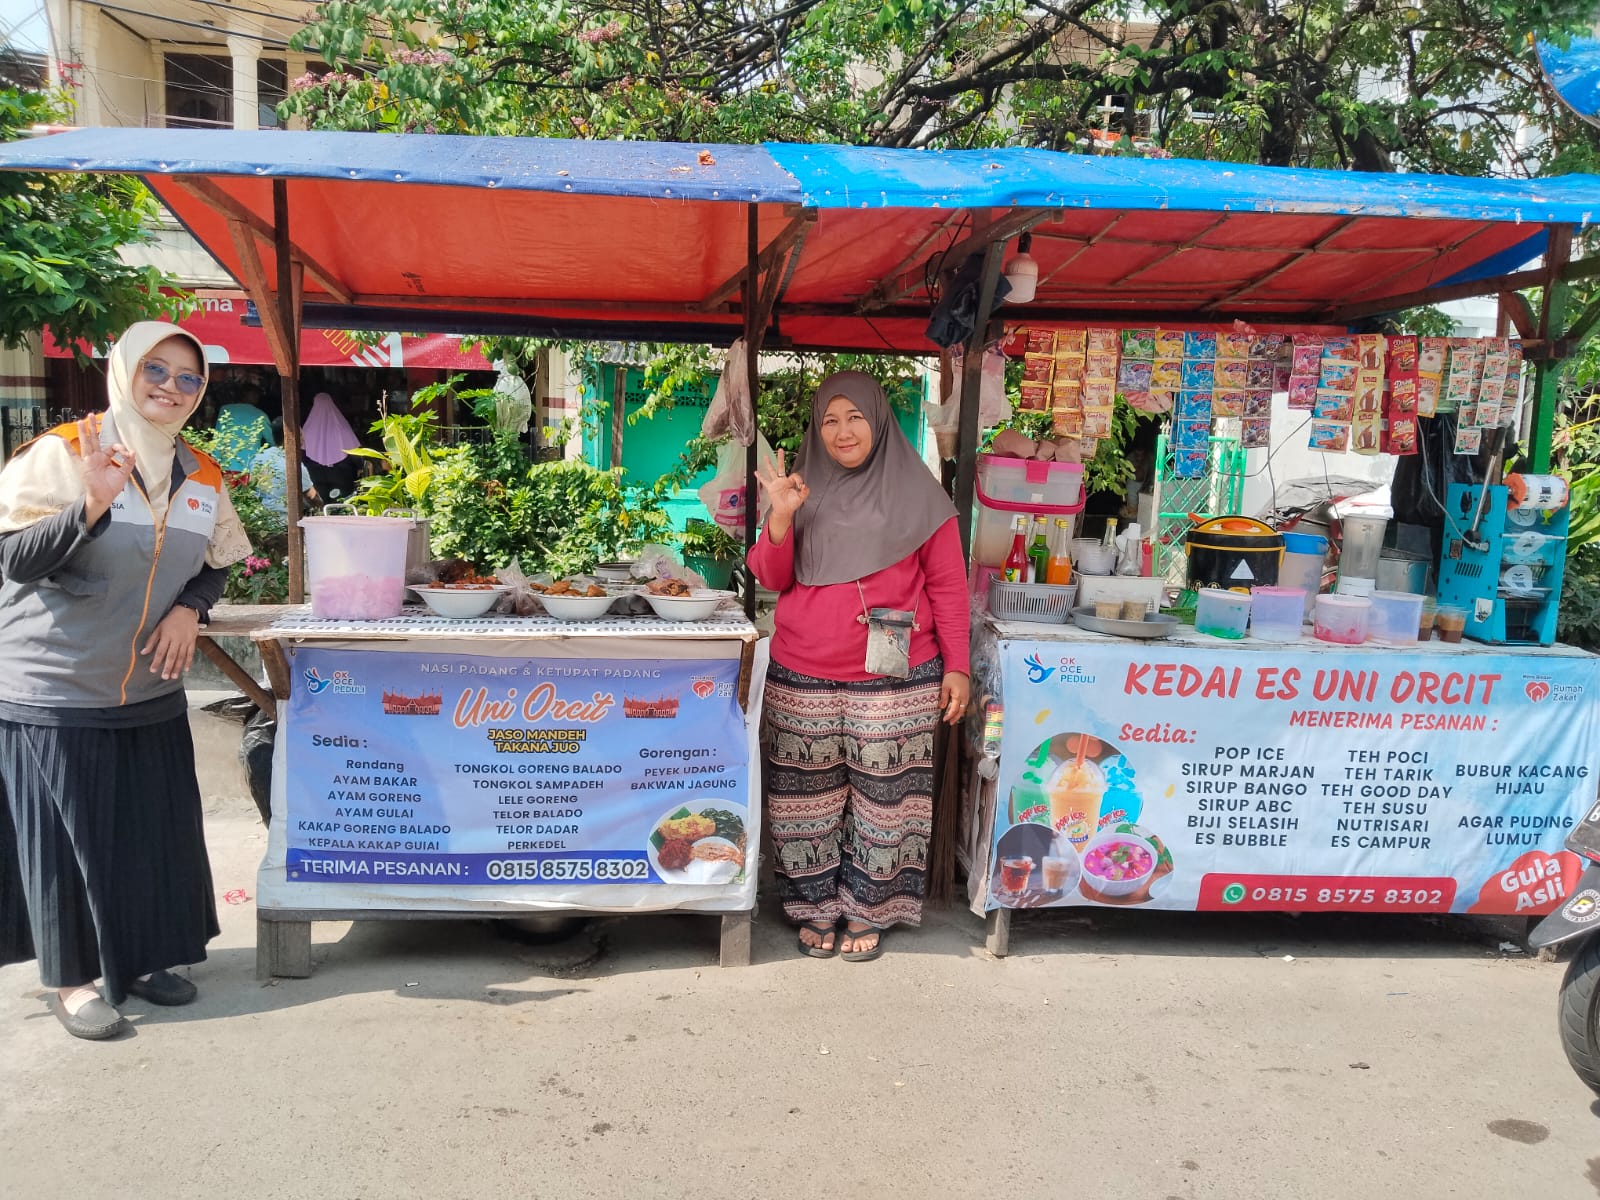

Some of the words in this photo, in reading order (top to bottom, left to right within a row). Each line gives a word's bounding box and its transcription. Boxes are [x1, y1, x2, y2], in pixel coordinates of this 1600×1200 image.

[111, 502, 125, 510] SIA
[334, 671, 349, 679] OK
[421, 664, 453, 673] NASI
[459, 665, 518, 676] PADANG
[522, 668, 531, 676] &
[537, 668, 599, 678] KETUPAT
[604, 669, 662, 679] PADANG
[1060, 666, 1082, 674] OCE
[333, 678, 353, 686] OCE
[1060, 674, 1096, 684] PEDULI
[1124, 662, 1242, 698] KEDAI
[1255, 667, 1301, 700] ES
[1313, 670, 1379, 703] UNI
[1390, 671, 1502, 705] ORCIT
[333, 686, 366, 694] PEDULI
[1553, 684, 1583, 692] Rumah
[1552, 693, 1577, 701] Zakat
[454, 687, 517, 728] Uni
[522, 682, 615, 723] Orcit
[1290, 710, 1392, 730] MENERIMA
[1400, 712, 1487, 731] PESANAN
[488, 729, 523, 740] JASO
[526, 730, 587, 741] MANDEH
[1118, 722, 1196, 744] Sedia:
[312, 734, 360, 748] Sedia
[494, 741, 549, 752] TAKANA
[551, 742, 580, 753] JUO
[640, 747, 710, 760] Gorengan
[1214, 746, 1250, 760] POP
[1257, 748, 1284, 760] ICE
[1348, 750, 1380, 763] TEH
[1387, 752, 1428, 764] POCI
[346, 760, 404, 772] Rendang
[454, 764, 515, 775] TONGKOL
[518, 764, 570, 774] GORENG
[572, 764, 622, 774] BALADO
[644, 767, 680, 777] PEYEK
[684, 765, 725, 775] UDANG
[1182, 763, 1233, 777] SIRUP
[1240, 765, 1315, 778] MARJAN
[1456, 764, 1512, 778] BUBUR
[1518, 765, 1589, 778] KACANG
[1345, 767, 1376, 780] TEH
[1384, 768, 1433, 781] TARIK
[333, 776, 370, 786] AYAM
[374, 777, 418, 787] BAKAR
[473, 780, 534, 790] TONGKOL
[536, 780, 604, 790] SAMPADEH
[630, 780, 685, 790] BAKWAN
[687, 779, 736, 790] JAGUNG
[1186, 781, 1238, 794] SIRUP
[1244, 782, 1307, 796] BANGO
[1322, 784, 1353, 796] TEH
[1360, 786, 1411, 798] GOOD
[1418, 786, 1452, 798] DAY
[1496, 782, 1545, 795] HIJAU
[328, 791, 366, 801] AYAM
[369, 792, 422, 802] GORENG
[498, 796, 524, 804] LELE
[526, 795, 578, 804] GORENG
[1198, 799, 1249, 812] SIRUP
[1256, 800, 1293, 813] ABC
[1344, 802, 1375, 814] TEH
[1382, 802, 1427, 815] SUSU
[336, 808, 374, 818] AYAM
[376, 808, 413, 818] GULAI
[493, 810, 530, 820] TELOR
[533, 808, 583, 819] BALADO
[298, 821, 340, 832] KAKAP
[344, 824, 396, 834] GORENG
[400, 824, 451, 835] BALADO
[1187, 816, 1221, 828] BIJI
[1228, 817, 1299, 830] SELASIH
[1337, 818, 1429, 832] NUTRISARI
[1458, 816, 1504, 828] AGAR
[1510, 816, 1574, 829] PUDING
[496, 825, 533, 834] TELOR
[536, 825, 578, 834] DADAR
[308, 838, 354, 849] KEPALA
[358, 840, 401, 850] KAKAP
[508, 840, 566, 850] PERKEDEL
[1196, 833, 1215, 845] ES
[1223, 834, 1288, 847] BUBBLE
[1331, 836, 1351, 848] ES
[1358, 836, 1431, 849] CAMPUR
[1486, 833, 1542, 846] LUMUT
[301, 859, 370, 874] TERIMA
[374, 861, 461, 876] PESANAN
[487, 860, 538, 879] 0815
[541, 860, 592, 878] 8575
[595, 860, 648, 878] 8302
[1500, 858, 1561, 893] Gula
[1252, 887, 1308, 902] 0815
[1316, 888, 1375, 904] 8575
[1384, 889, 1442, 904] 8302
[1514, 877, 1565, 912] Asli
